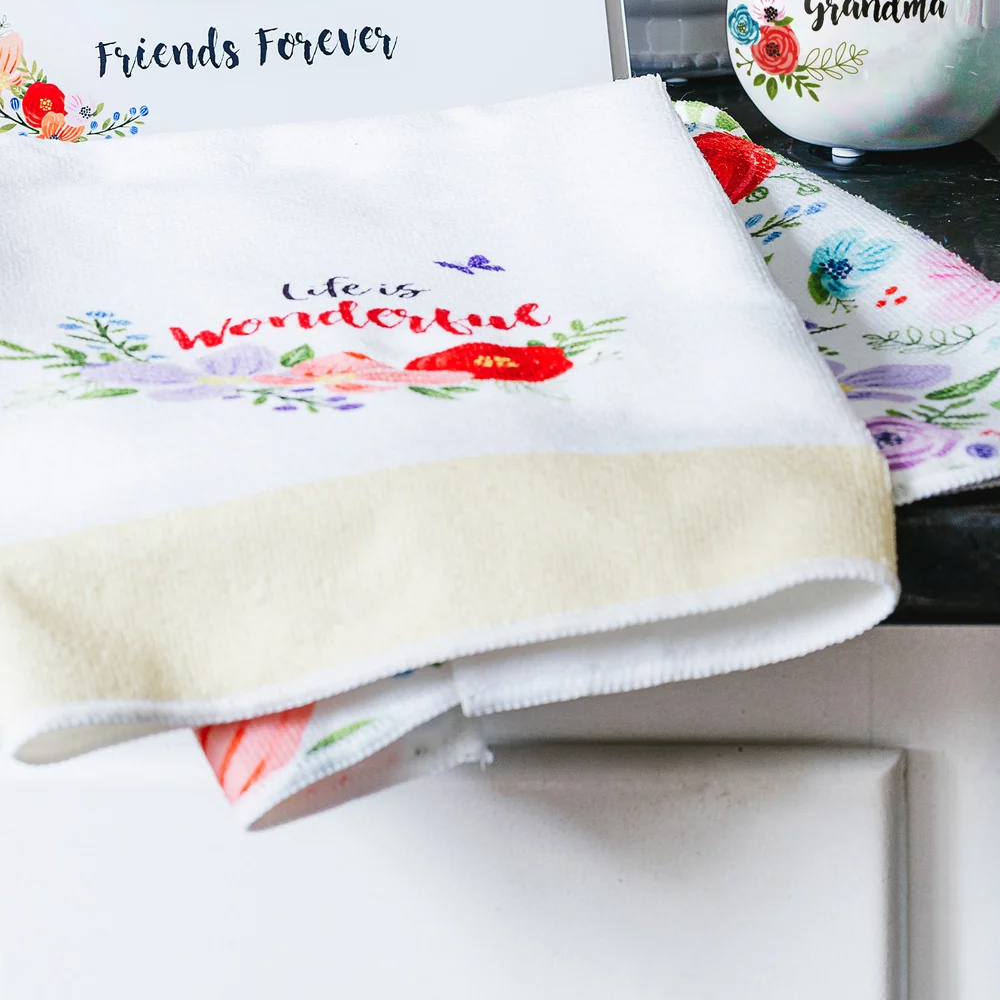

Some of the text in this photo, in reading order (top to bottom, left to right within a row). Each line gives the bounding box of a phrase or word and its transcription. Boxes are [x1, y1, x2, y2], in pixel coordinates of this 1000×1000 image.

[95, 26, 397, 78] Friends Forever
[283, 277, 427, 302] Life is
[170, 301, 552, 350] wonderful
